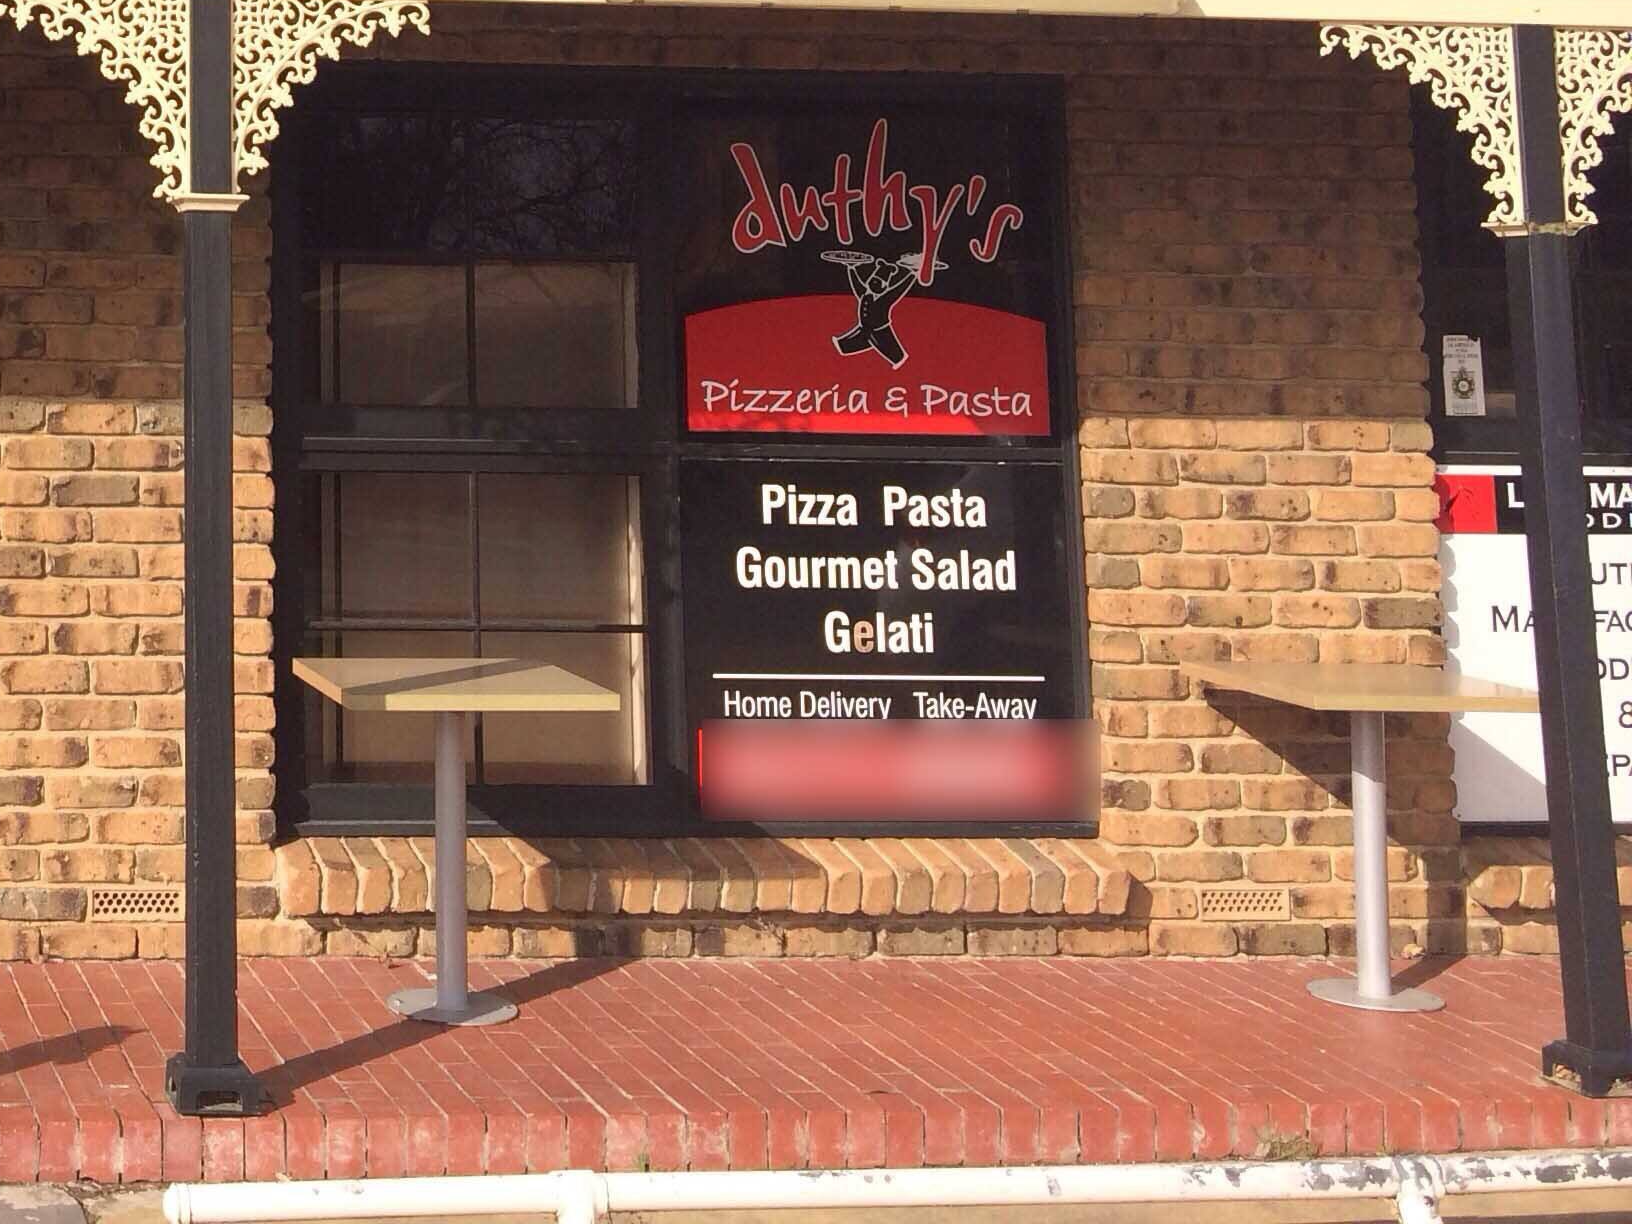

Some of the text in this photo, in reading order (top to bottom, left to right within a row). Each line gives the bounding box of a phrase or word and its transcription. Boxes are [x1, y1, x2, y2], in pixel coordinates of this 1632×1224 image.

[730, 117, 1023, 286] duthy's
[884, 386, 909, 418] &
[921, 384, 1032, 418] Pasta
[760, 483, 988, 528] Pizza Pasta
[735, 545, 1017, 592] Gourmet Salad
[823, 610, 935, 654] Gelati
[723, 691, 892, 720] Home Delivery
[913, 691, 1038, 720] Take-Away
